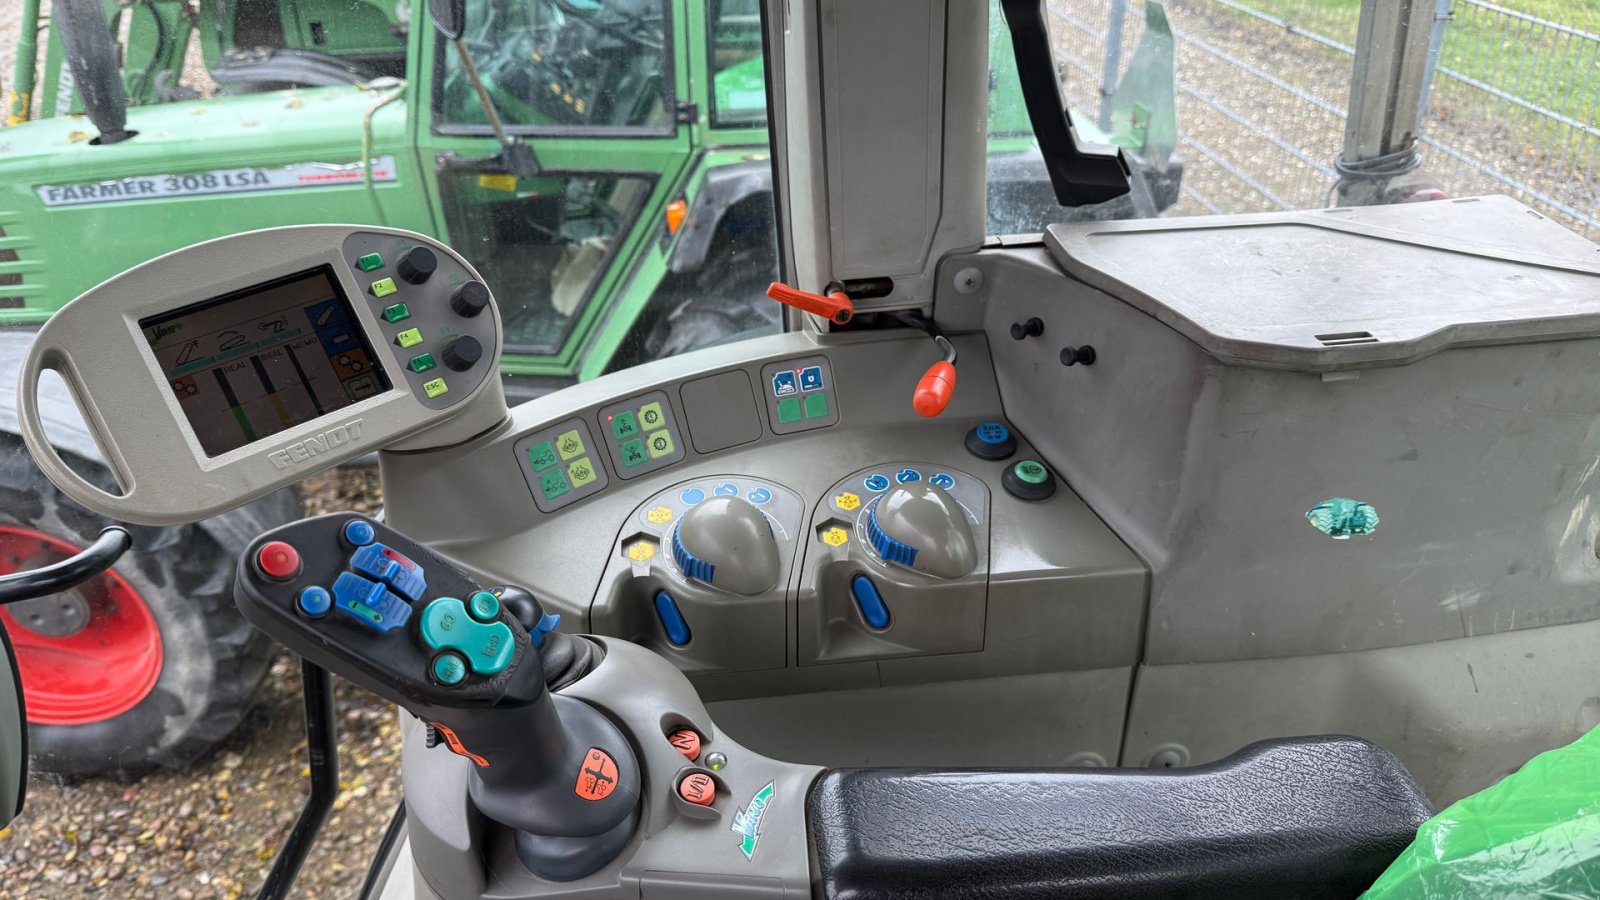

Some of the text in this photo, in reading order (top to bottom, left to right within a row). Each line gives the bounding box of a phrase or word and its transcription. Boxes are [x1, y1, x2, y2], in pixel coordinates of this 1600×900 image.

[48, 170, 270, 202] FARMER 308 LSA
[292, 337, 317, 350] MEMO
[223, 360, 248, 374] REAL
[425, 382, 440, 391] ESC
[268, 418, 363, 469] FENDT
[440, 613, 454, 631] GO
[671, 732, 695, 750] N
